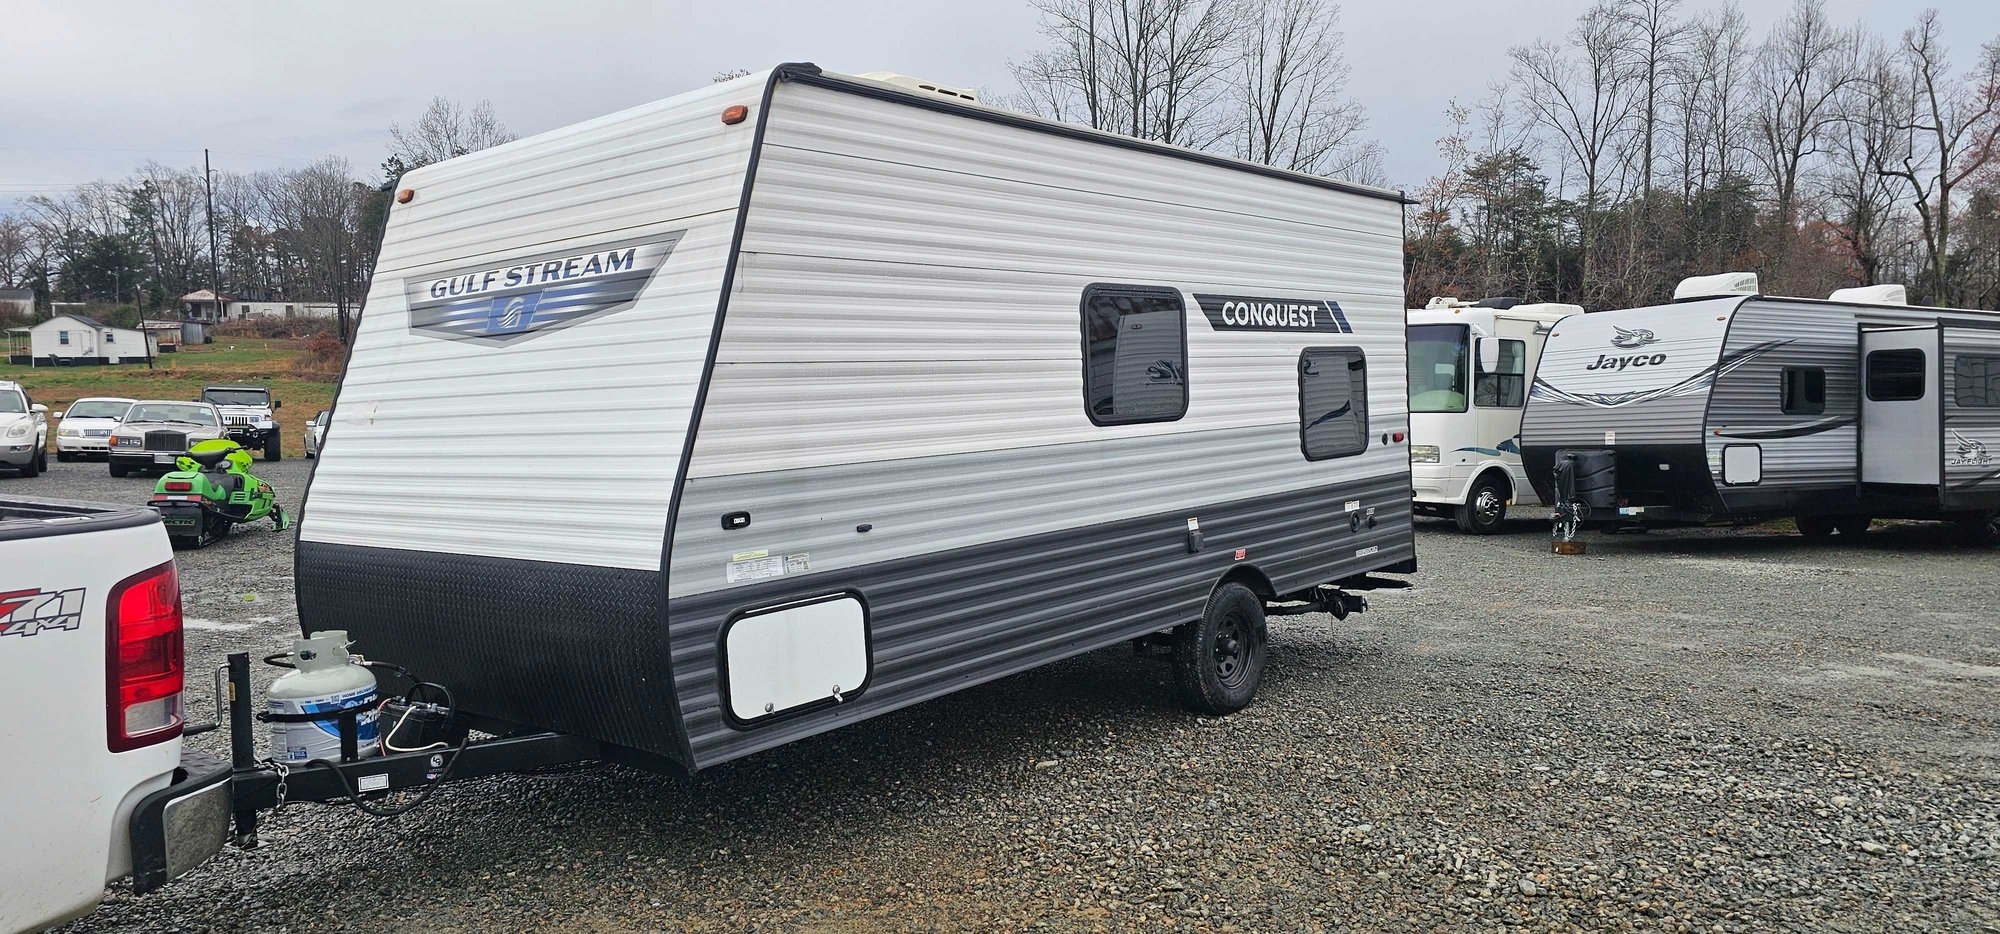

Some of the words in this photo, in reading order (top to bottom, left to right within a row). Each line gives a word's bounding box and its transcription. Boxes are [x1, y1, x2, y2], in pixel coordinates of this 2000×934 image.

[430, 271, 499, 299] GULF
[503, 248, 637, 288] STREAM
[1222, 301, 1318, 327] CONQUEST
[1586, 353, 1667, 371] Jayco
[1, 614, 81, 637] 4x4
